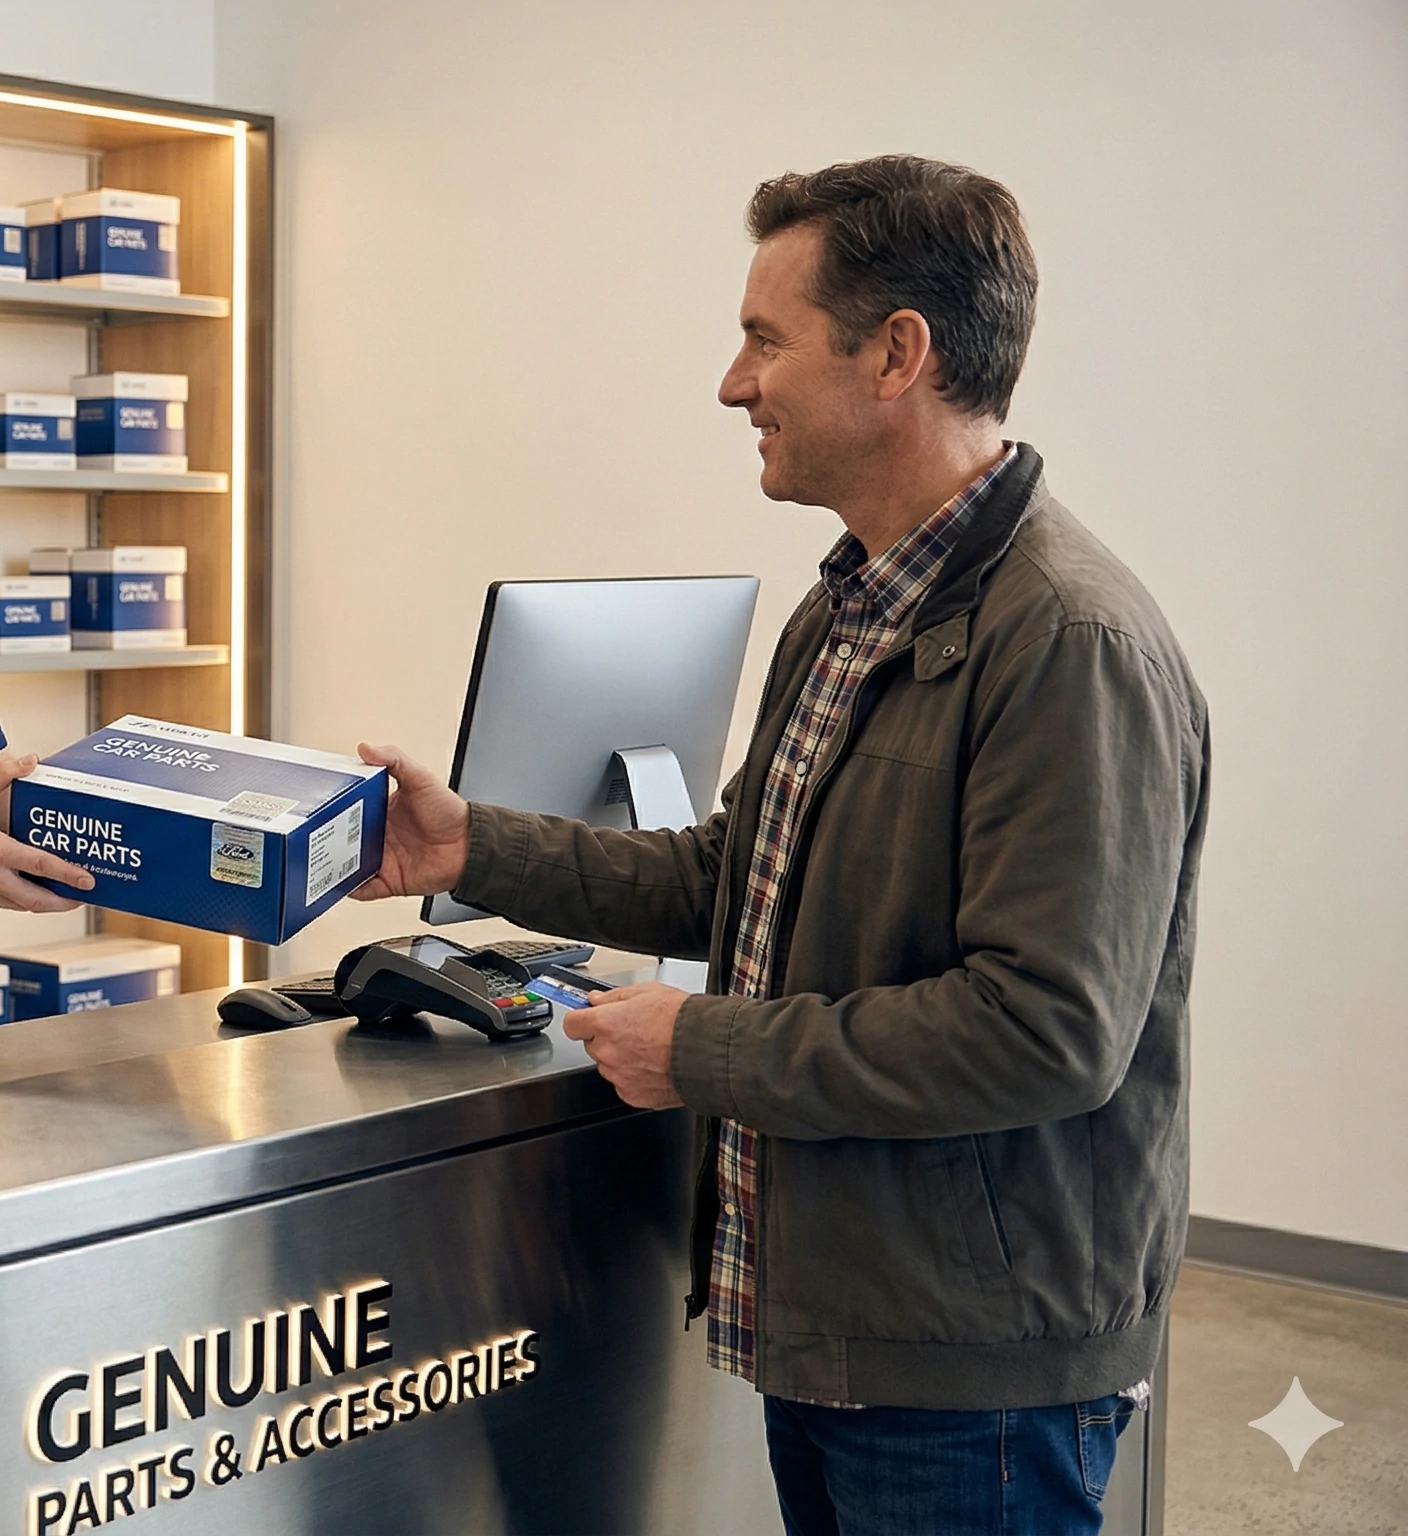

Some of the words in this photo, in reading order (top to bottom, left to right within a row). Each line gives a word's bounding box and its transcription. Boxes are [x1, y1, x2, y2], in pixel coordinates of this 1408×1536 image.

[93, 744, 142, 759] CAR
[143, 752, 220, 773] PARTS
[106, 736, 213, 762] GENUINE
[29, 806, 122, 842] GENUINE
[28, 828, 70, 853] CAR
[76, 837, 142, 868] PARTS
[31, 1281, 393, 1463] GENUINE
[32, 1446, 195, 1536] PARTS
[208, 1432, 242, 1486] &
[250, 1330, 542, 1473] ACCESSORIES
